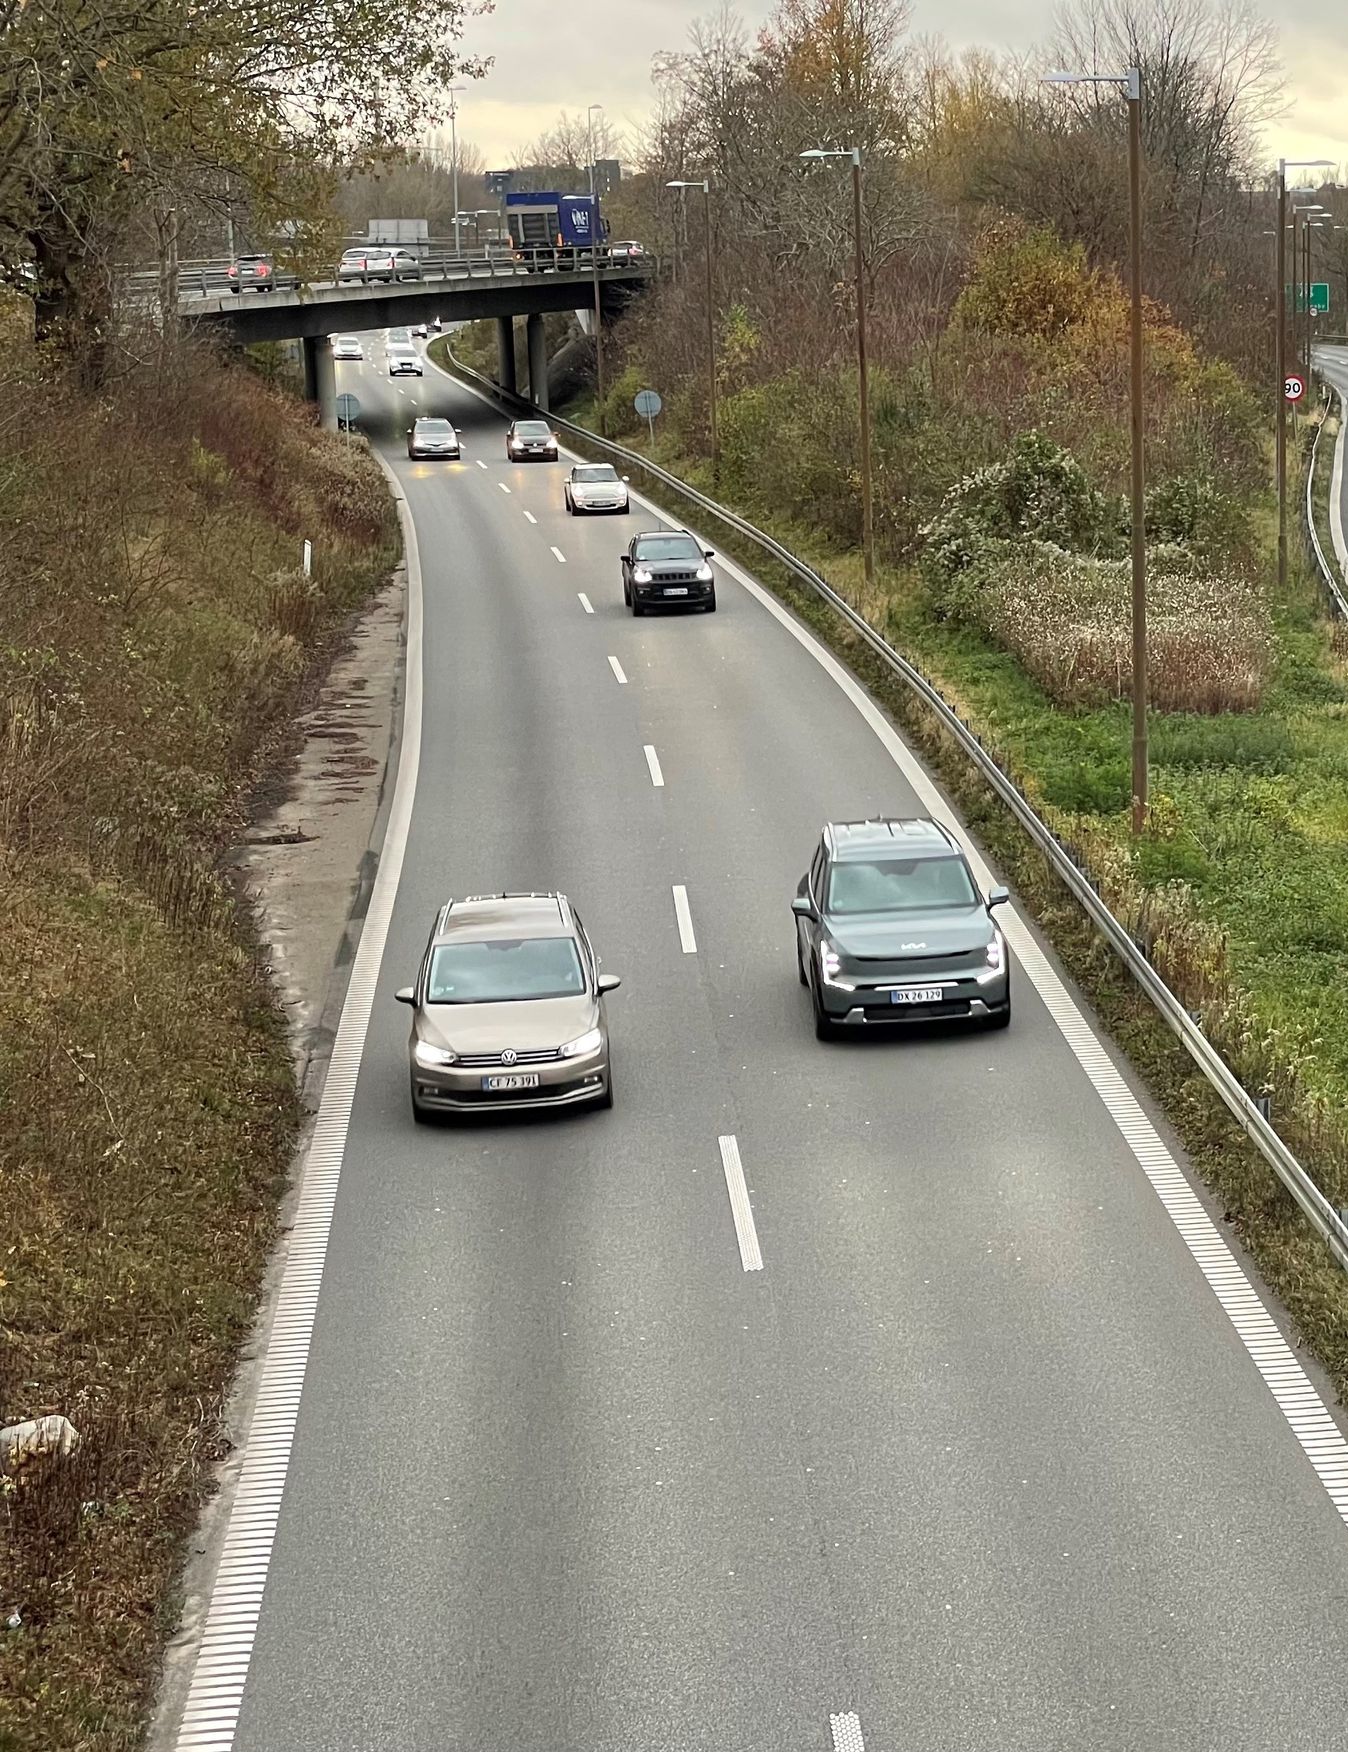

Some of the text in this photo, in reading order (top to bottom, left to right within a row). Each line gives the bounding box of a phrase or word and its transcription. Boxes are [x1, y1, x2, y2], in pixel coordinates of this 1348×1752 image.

[1285, 383, 1301, 394] 90
[897, 990, 941, 1002] DX 26 129
[506, 1076, 517, 1087] 75
